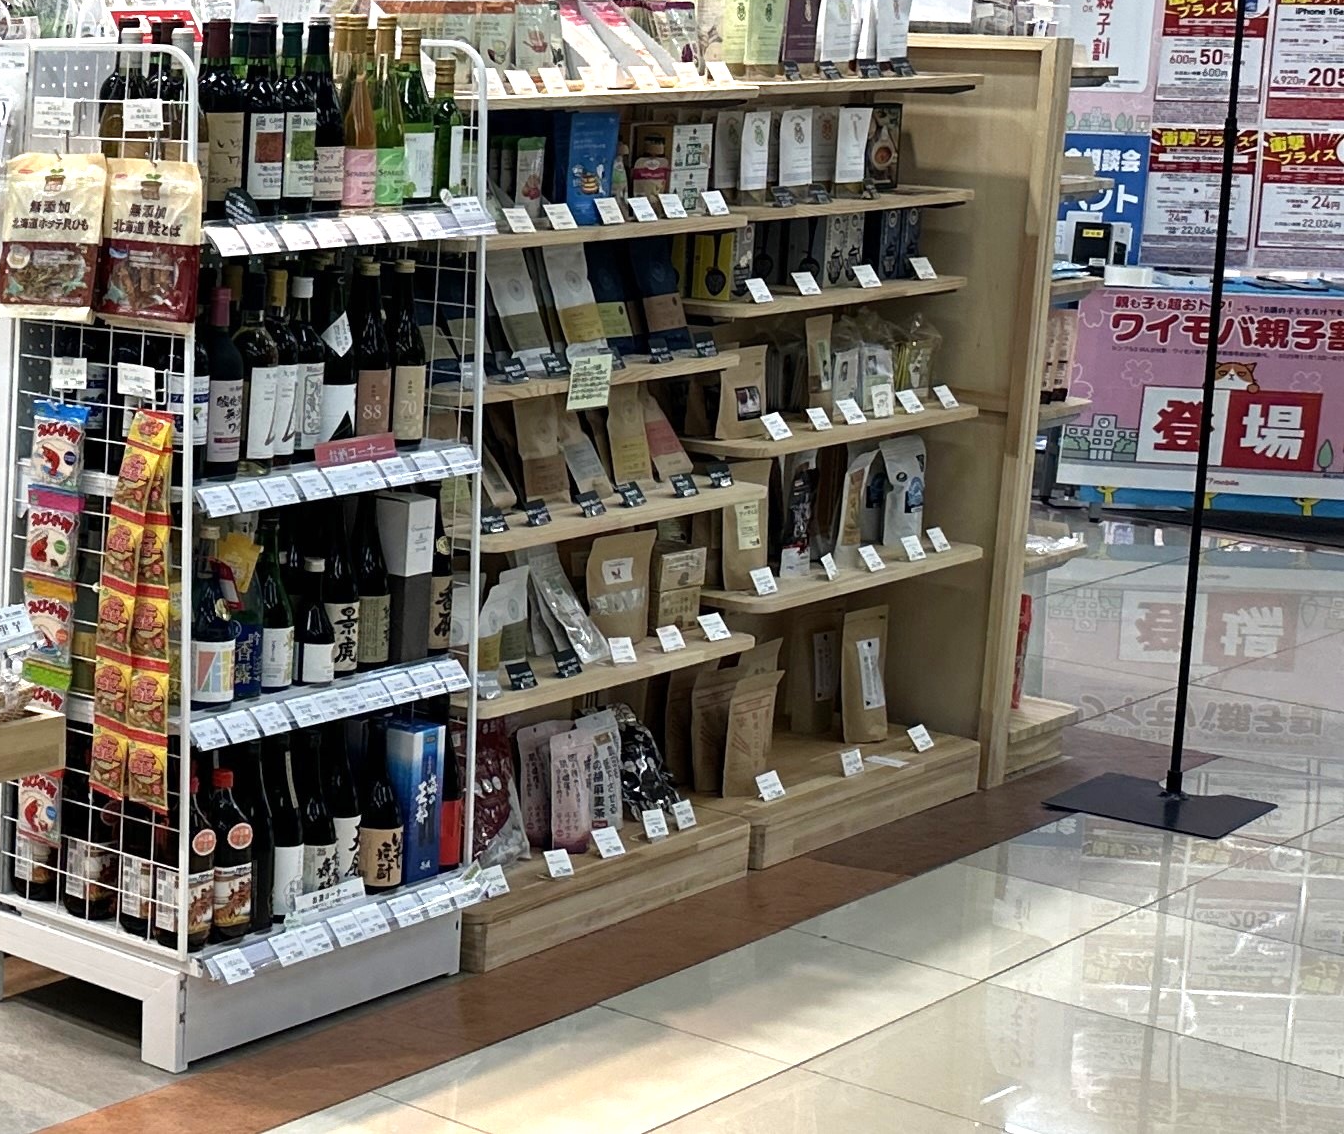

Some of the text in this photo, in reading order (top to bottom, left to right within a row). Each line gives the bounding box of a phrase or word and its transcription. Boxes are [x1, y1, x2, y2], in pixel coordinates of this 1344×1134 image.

[1177, 2, 1235, 18] プライス
[1295, 7, 1326, 15] iPhone
[1200, 49, 1223, 66] 50
[1278, 149, 1337, 165] プライス
[30, 199, 71, 214] 無添加
[129, 203, 167, 219] 無添加
[1311, 196, 1341, 210] 24円
[363, 405, 383, 419] 88
[399, 400, 418, 415] 70
[1153, 399, 1306, 461] 登場
[334, 606, 359, 665] 景虎
